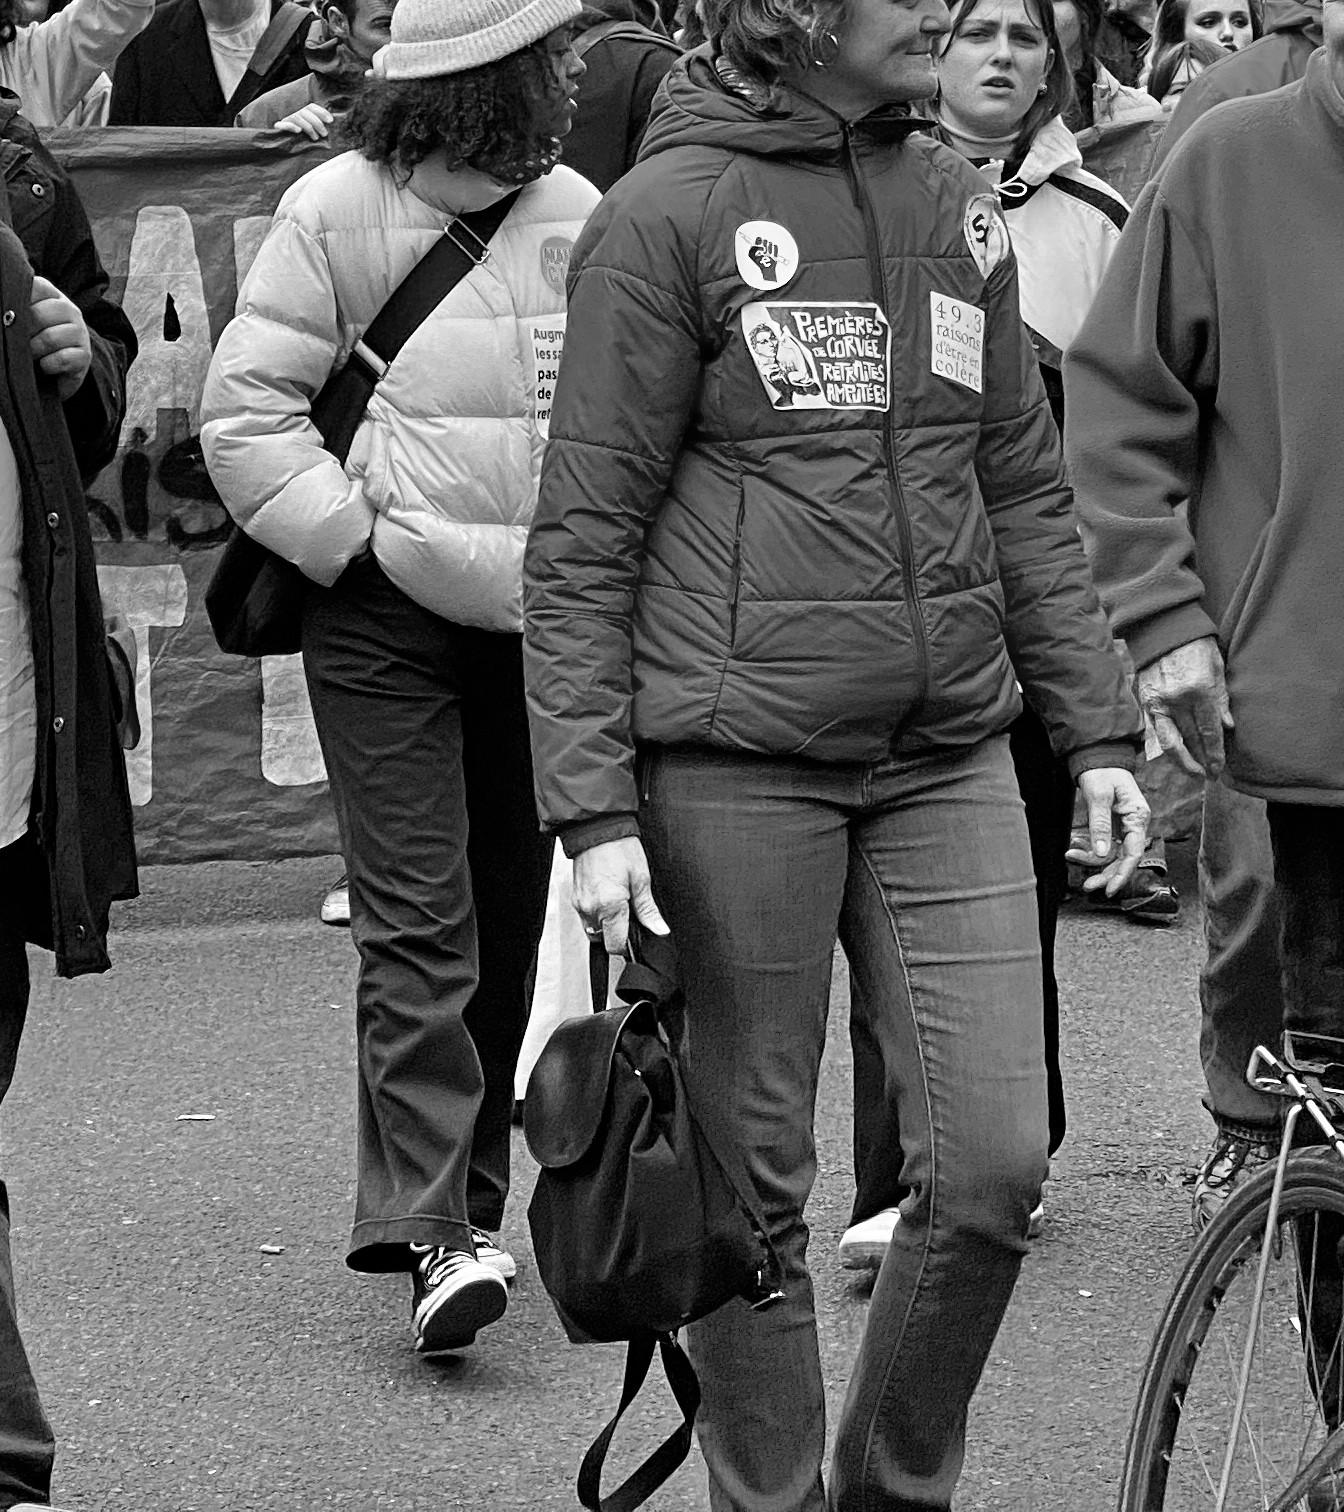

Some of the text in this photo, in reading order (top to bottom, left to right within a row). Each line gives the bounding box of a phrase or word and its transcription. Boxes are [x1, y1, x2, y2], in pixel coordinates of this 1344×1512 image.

[936, 324, 981, 353] raisons
[969, 355, 979, 371] en
[936, 359, 980, 389] colère
[537, 388, 552, 400] de
[826, 383, 885, 404] AMPUTÉES
